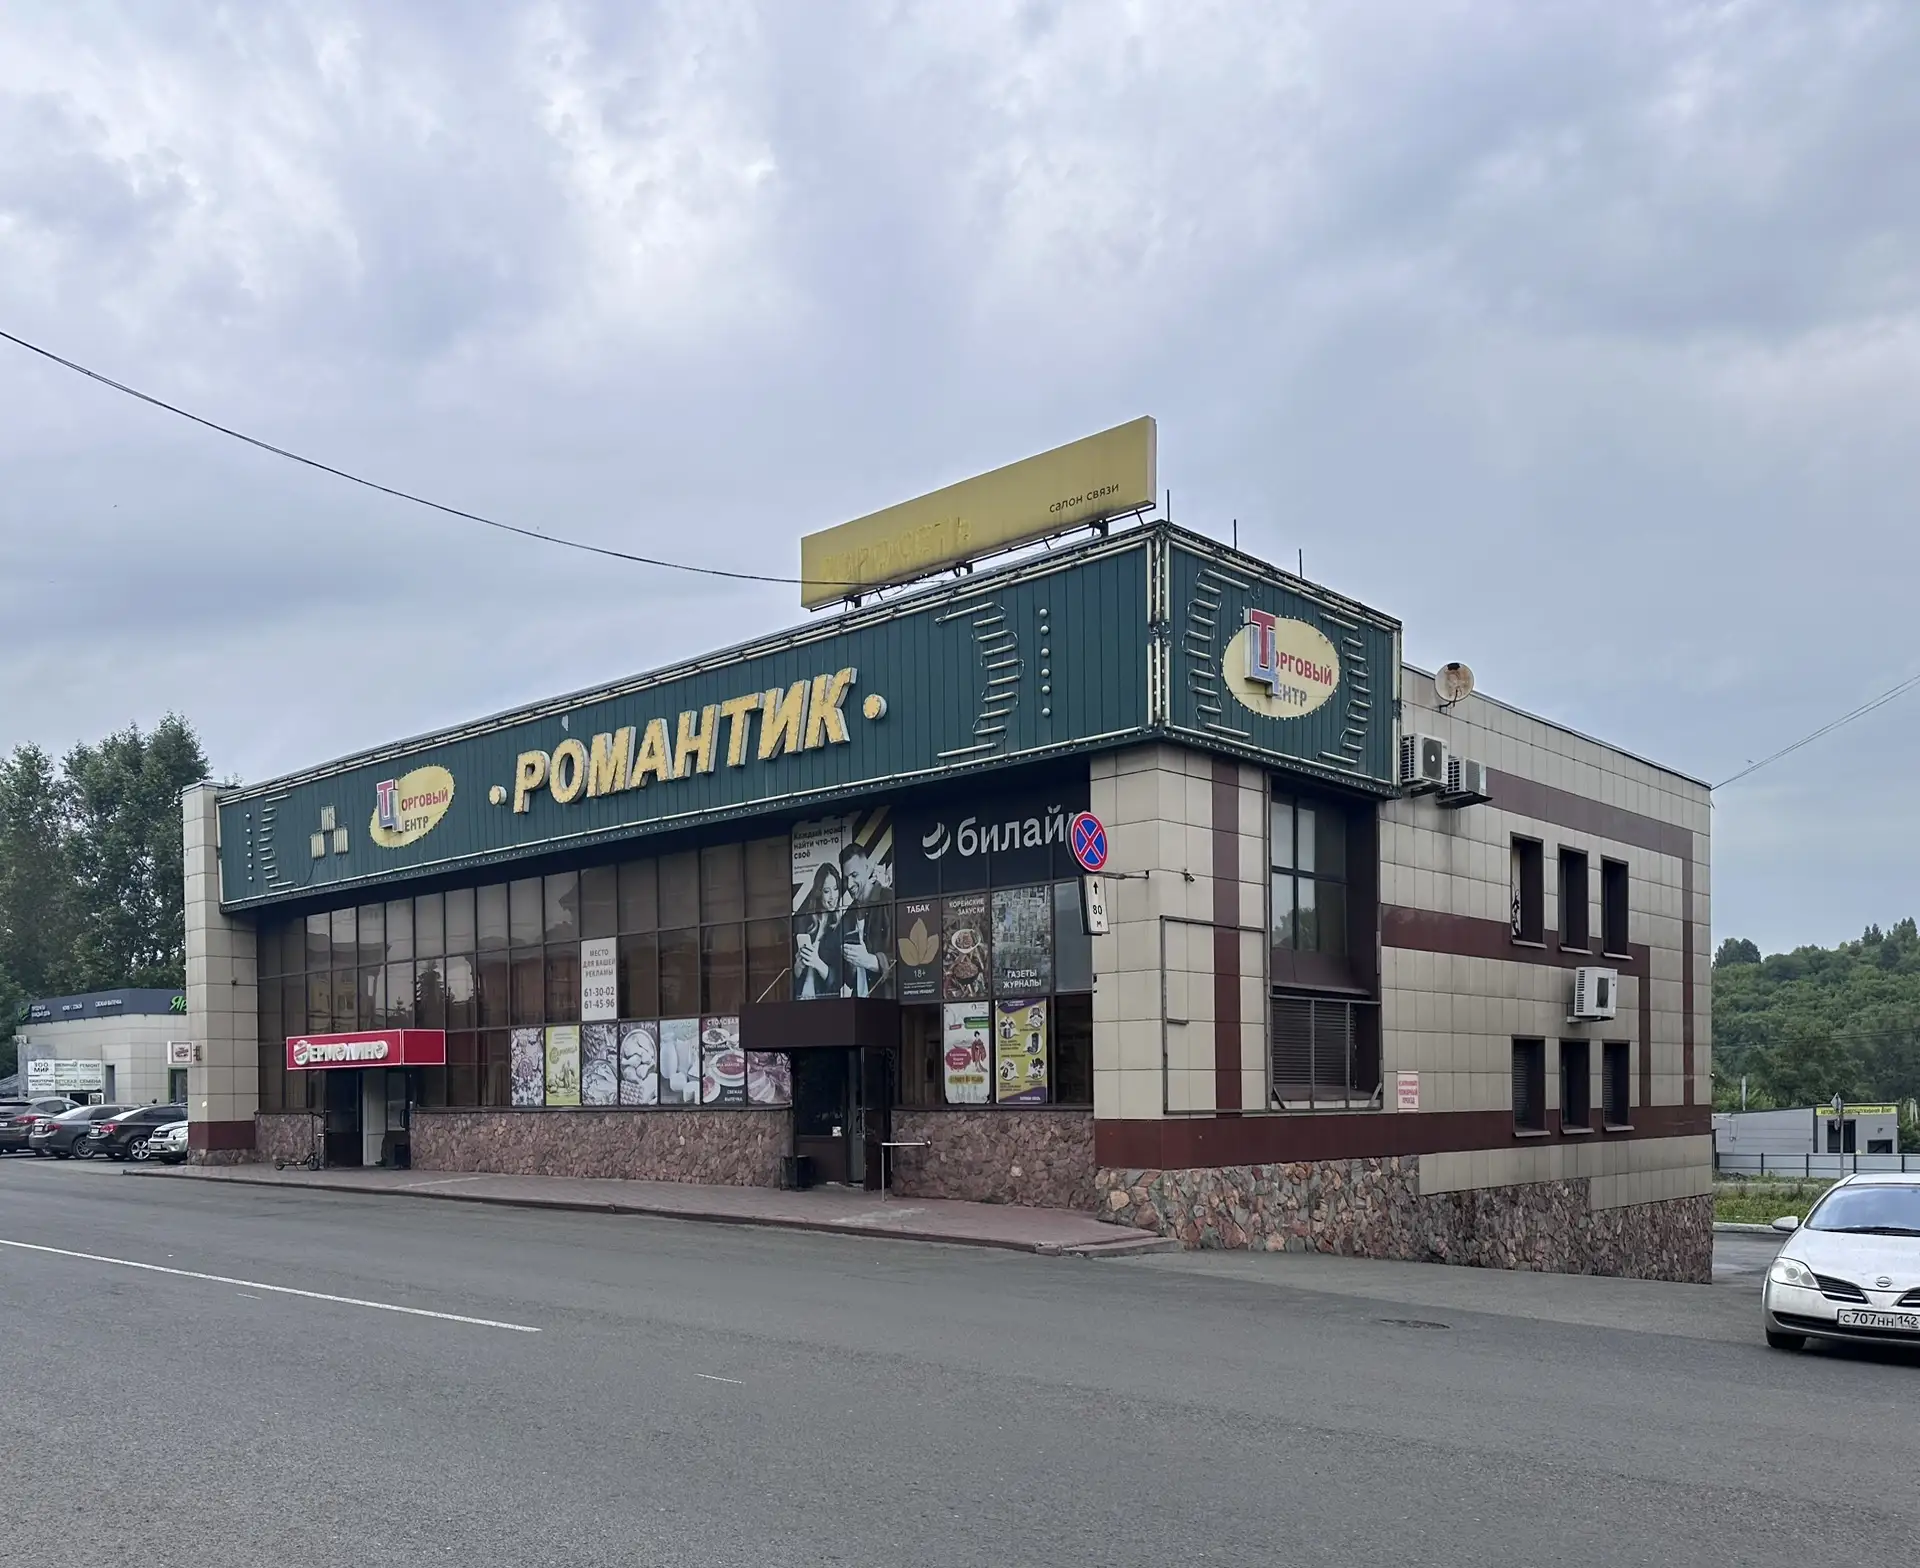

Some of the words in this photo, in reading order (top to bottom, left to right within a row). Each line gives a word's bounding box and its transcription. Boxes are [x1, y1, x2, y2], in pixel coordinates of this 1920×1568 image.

[1049, 494, 1083, 513] салон
[1086, 483, 1120, 503] связи
[513, 667, 858, 815] РОМАНТИК
[957, 804, 1080, 857] билай
[906, 903, 930, 914] ТАБАК
[957, 906, 985, 916] ЗАКУСКИ
[1092, 904, 1103, 915] 80
[589, 949, 609, 957] МЕСТО
[582, 960, 594, 968] ДЛЯ
[595, 958, 615, 967] ВАШЕЙ
[585, 969, 613, 978] РЕКЛАМЫ
[914, 969, 926, 978] 18+
[1006, 969, 1037, 979] ГАЗЕТЫ
[1003, 979, 1042, 989] ЖУРНАЛЫ
[583, 986, 615, 997] 61-30-02
[583, 998, 615, 1009] 61-45-96
[707, 1017, 739, 1026] СТОЛОВАЯ
[309, 1040, 389, 1062] ЕРМОЛИНО
[1897, 1315, 1918, 1326] 142
